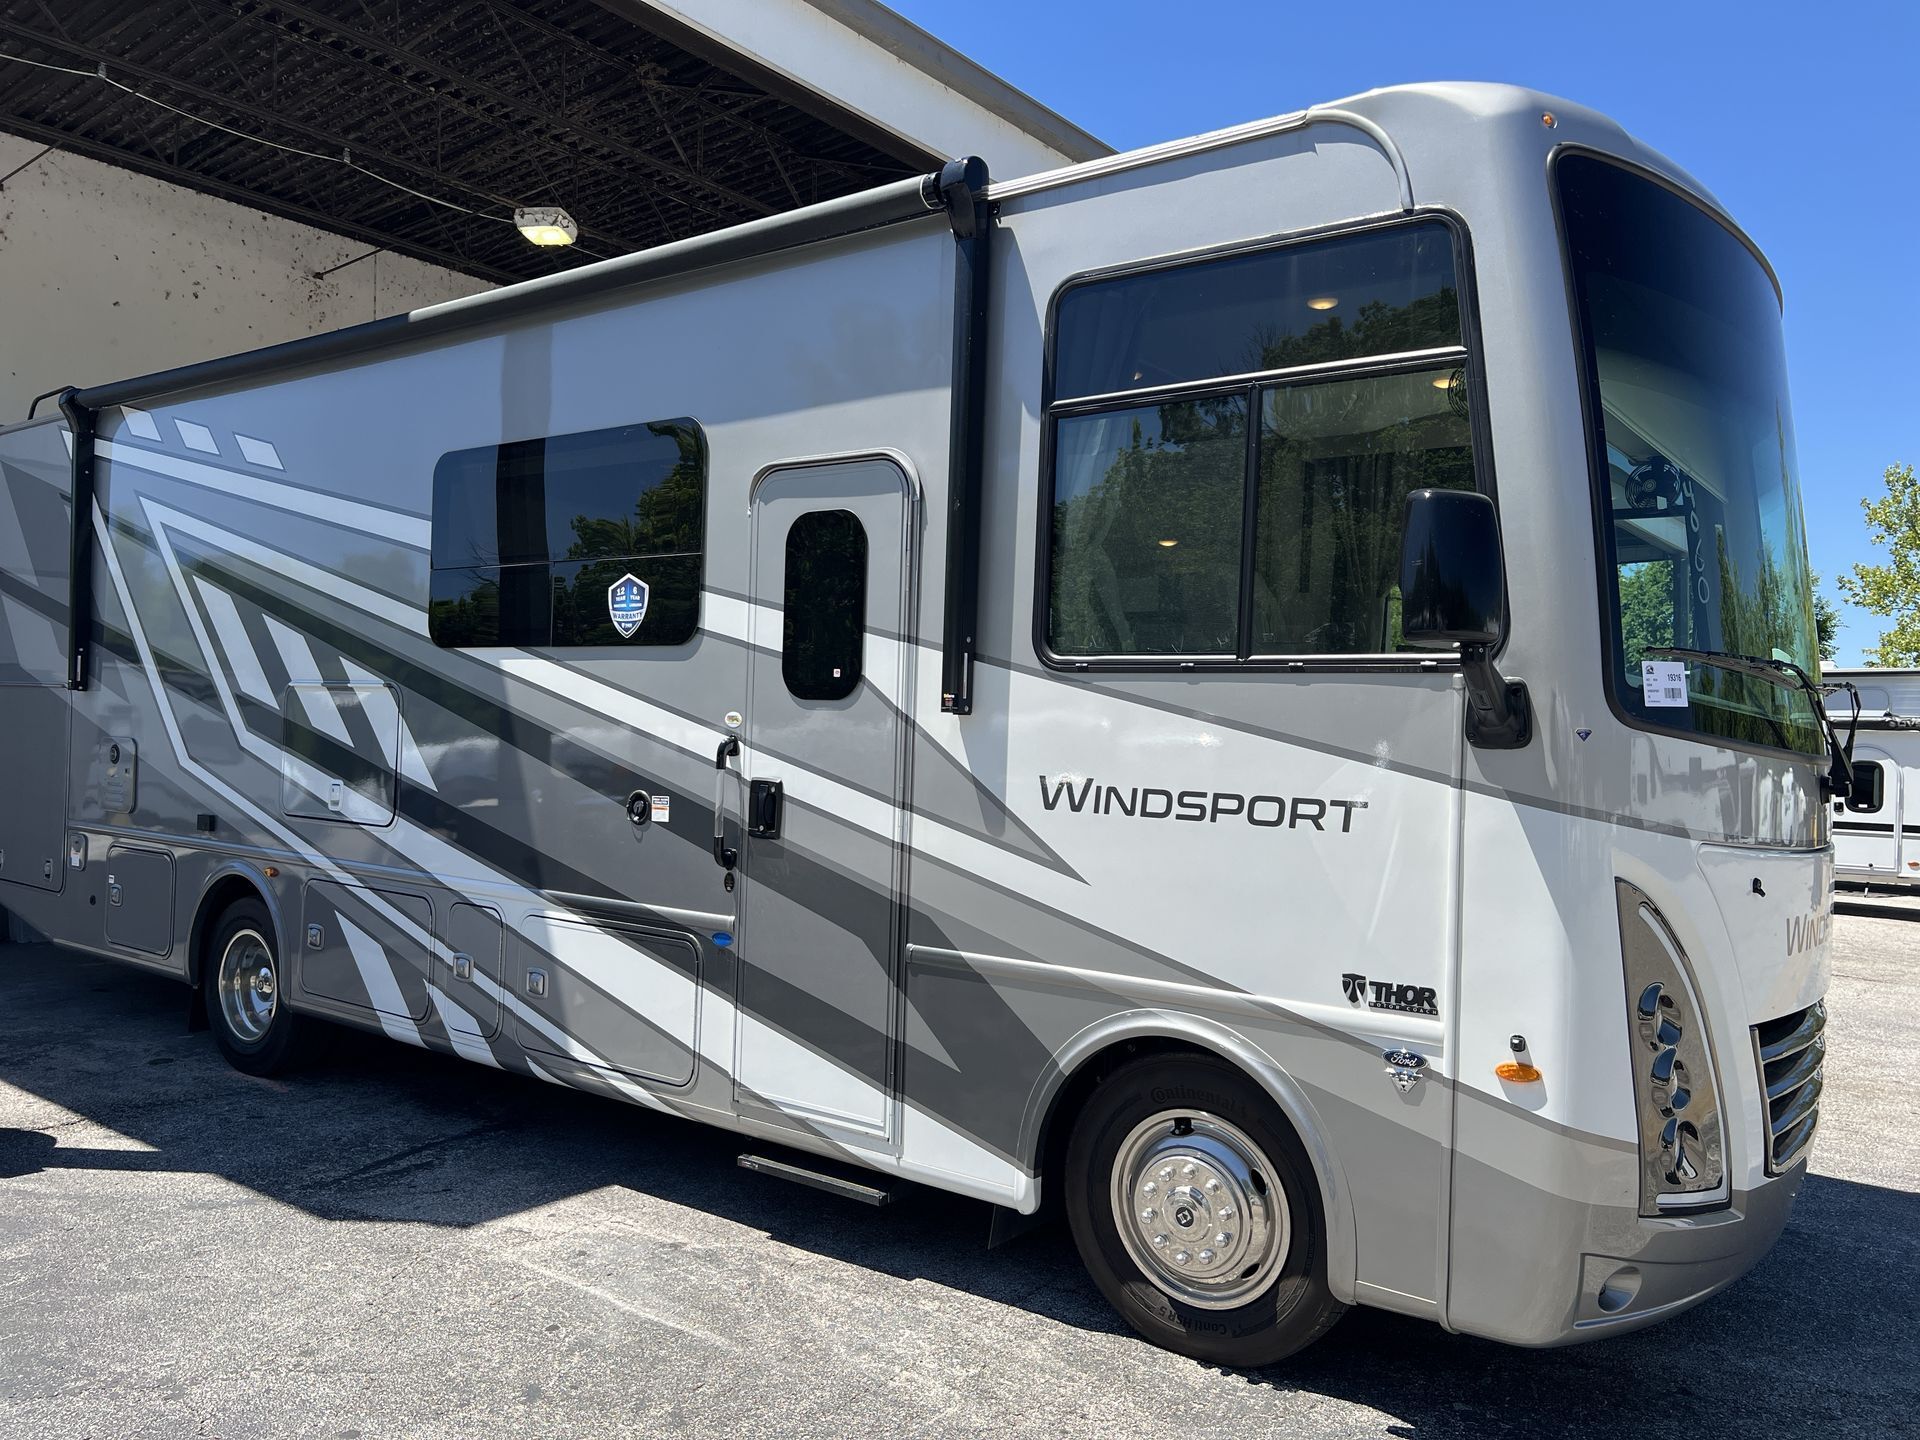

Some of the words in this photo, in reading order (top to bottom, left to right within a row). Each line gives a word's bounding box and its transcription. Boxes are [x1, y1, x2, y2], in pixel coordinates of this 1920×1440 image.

[616, 586, 625, 595] 12
[632, 586, 638, 594] 6
[612, 612, 642, 620] WARRANTY
[1039, 775, 1369, 834] WINDSPORT
[1368, 980, 1438, 1009] THOR
[1406, 1006, 1437, 1014] COACH
[1390, 1052, 1418, 1067] Ford
[1150, 1084, 1236, 1111] Continental
